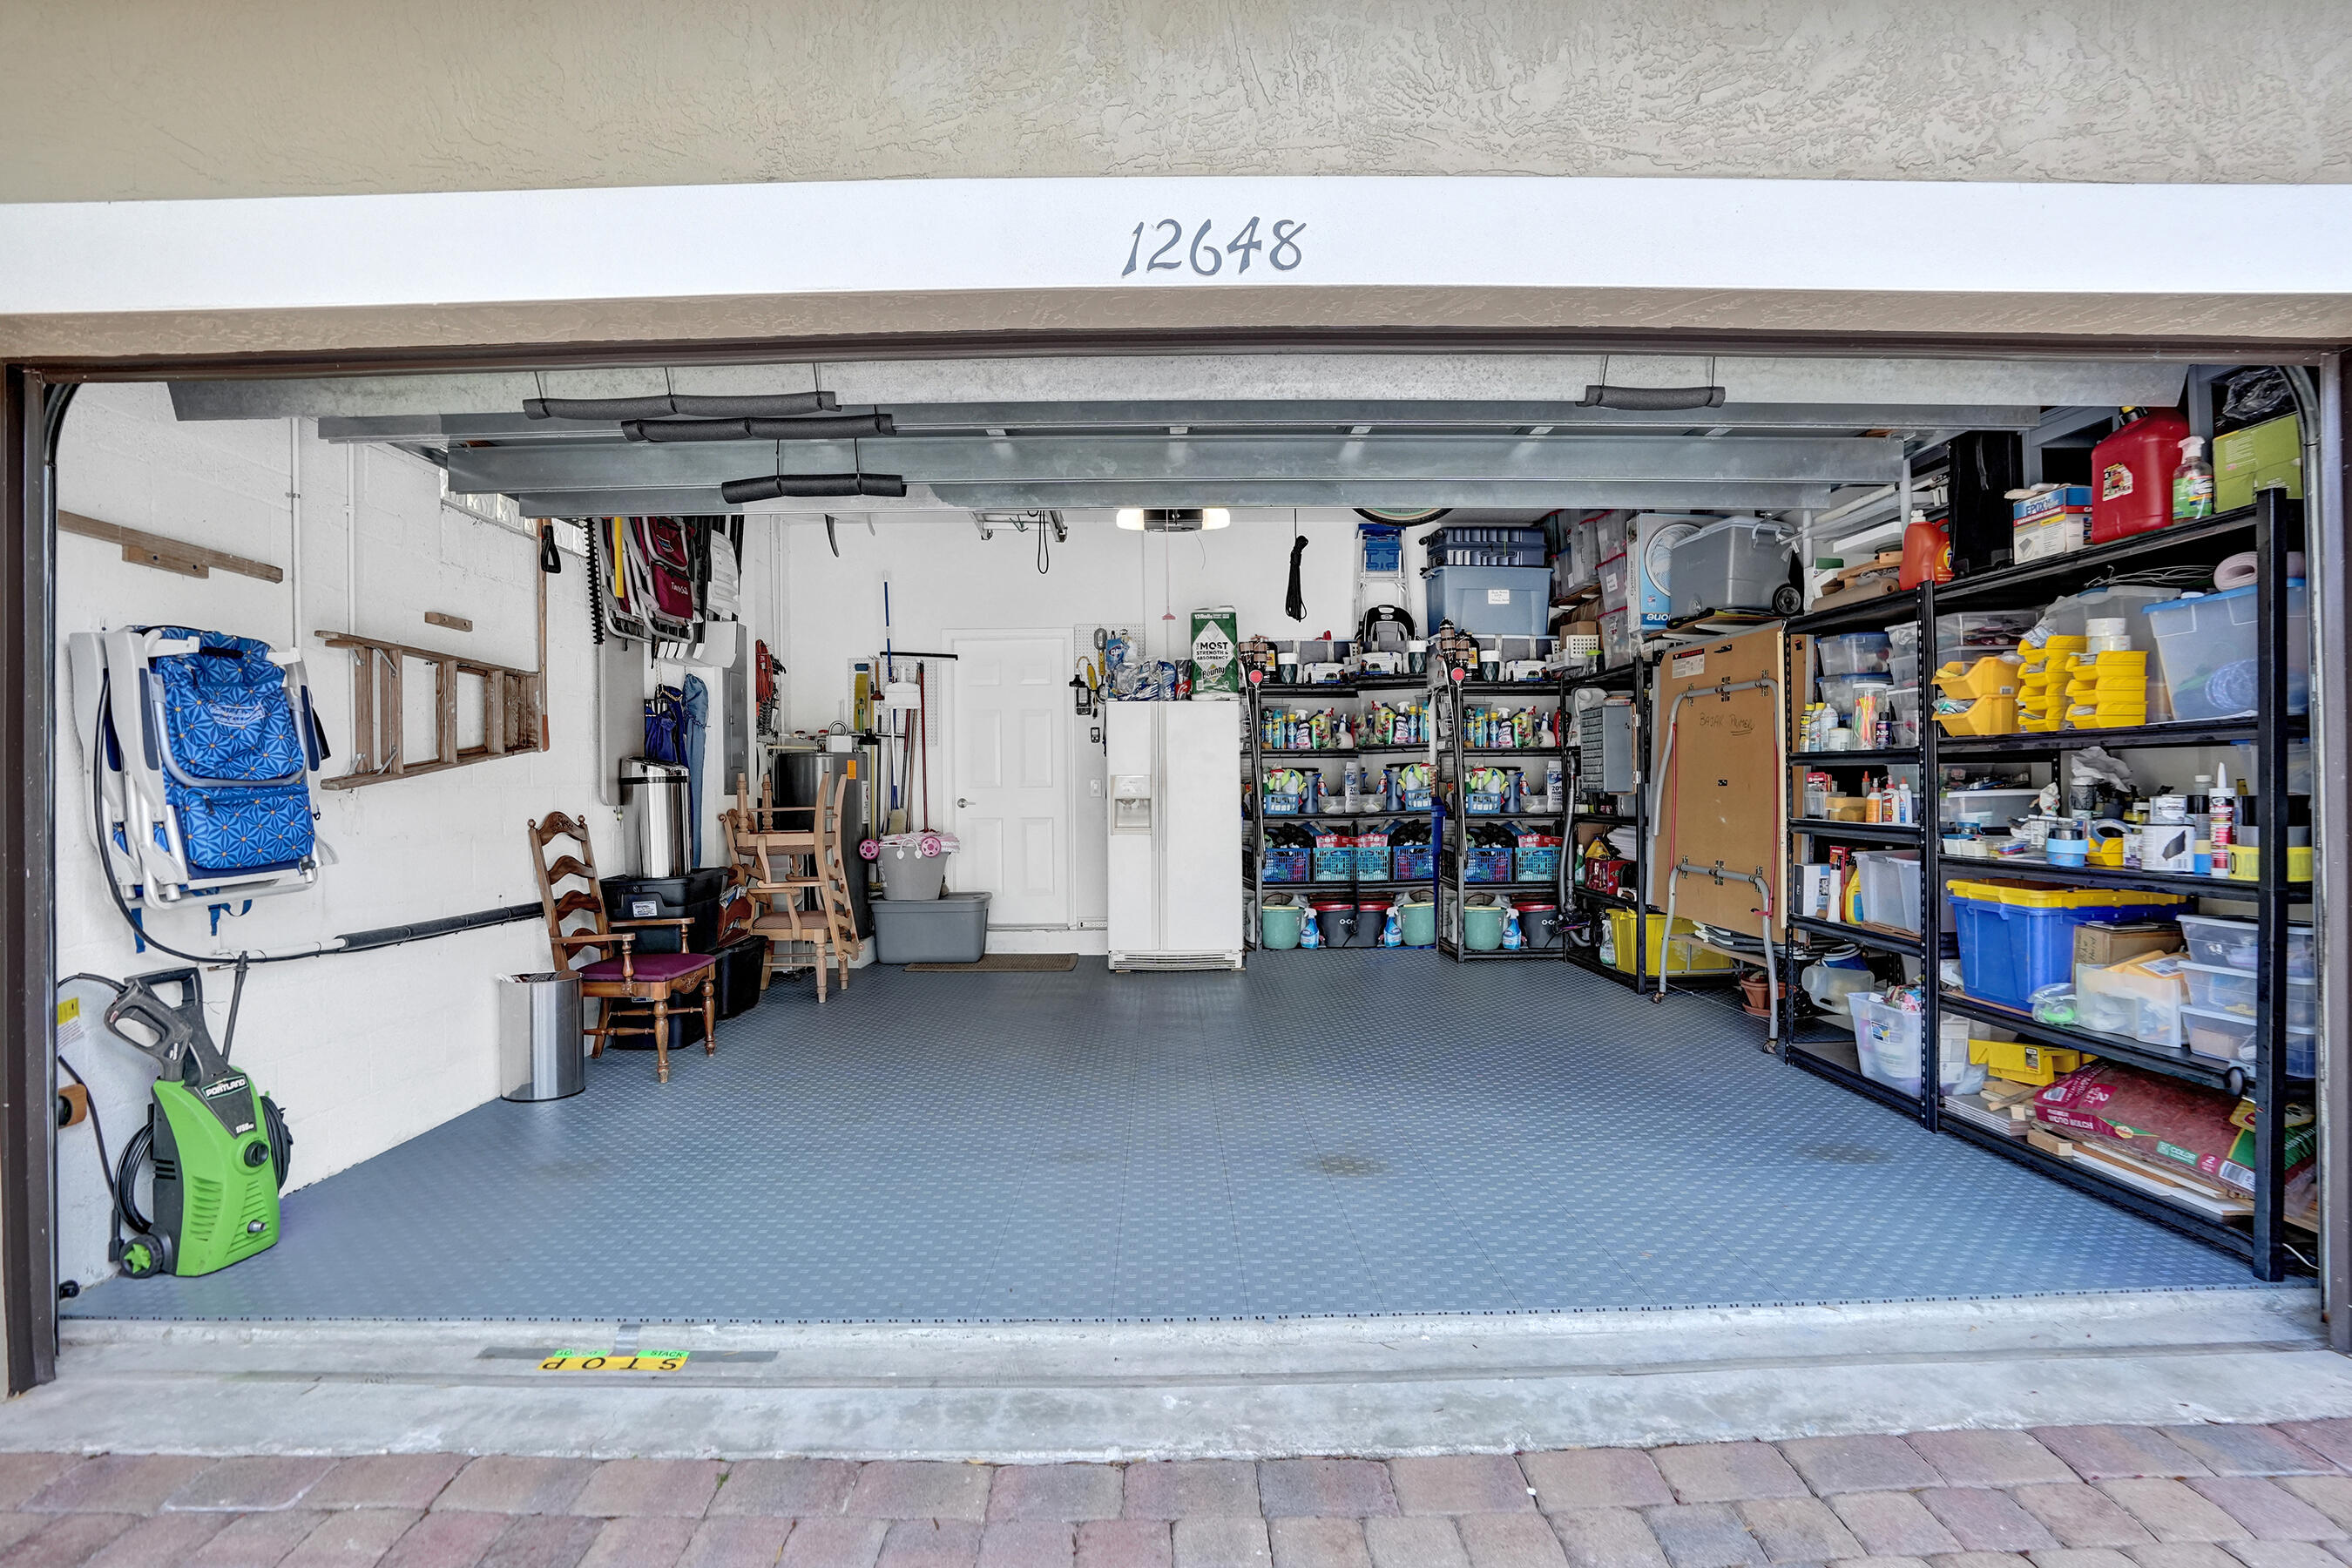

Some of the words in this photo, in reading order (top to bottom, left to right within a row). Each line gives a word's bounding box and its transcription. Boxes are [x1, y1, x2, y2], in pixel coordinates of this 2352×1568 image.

[1121, 216, 1307, 276] 12648
[2025, 498, 2051, 517] EPOXY
[1200, 641, 1228, 650] MOST
[1202, 666, 1225, 679] Bounty
[206, 1079, 246, 1097] PORTLAND
[2206, 1155, 2216, 1165] 2
[542, 1357, 678, 1370] STOP
